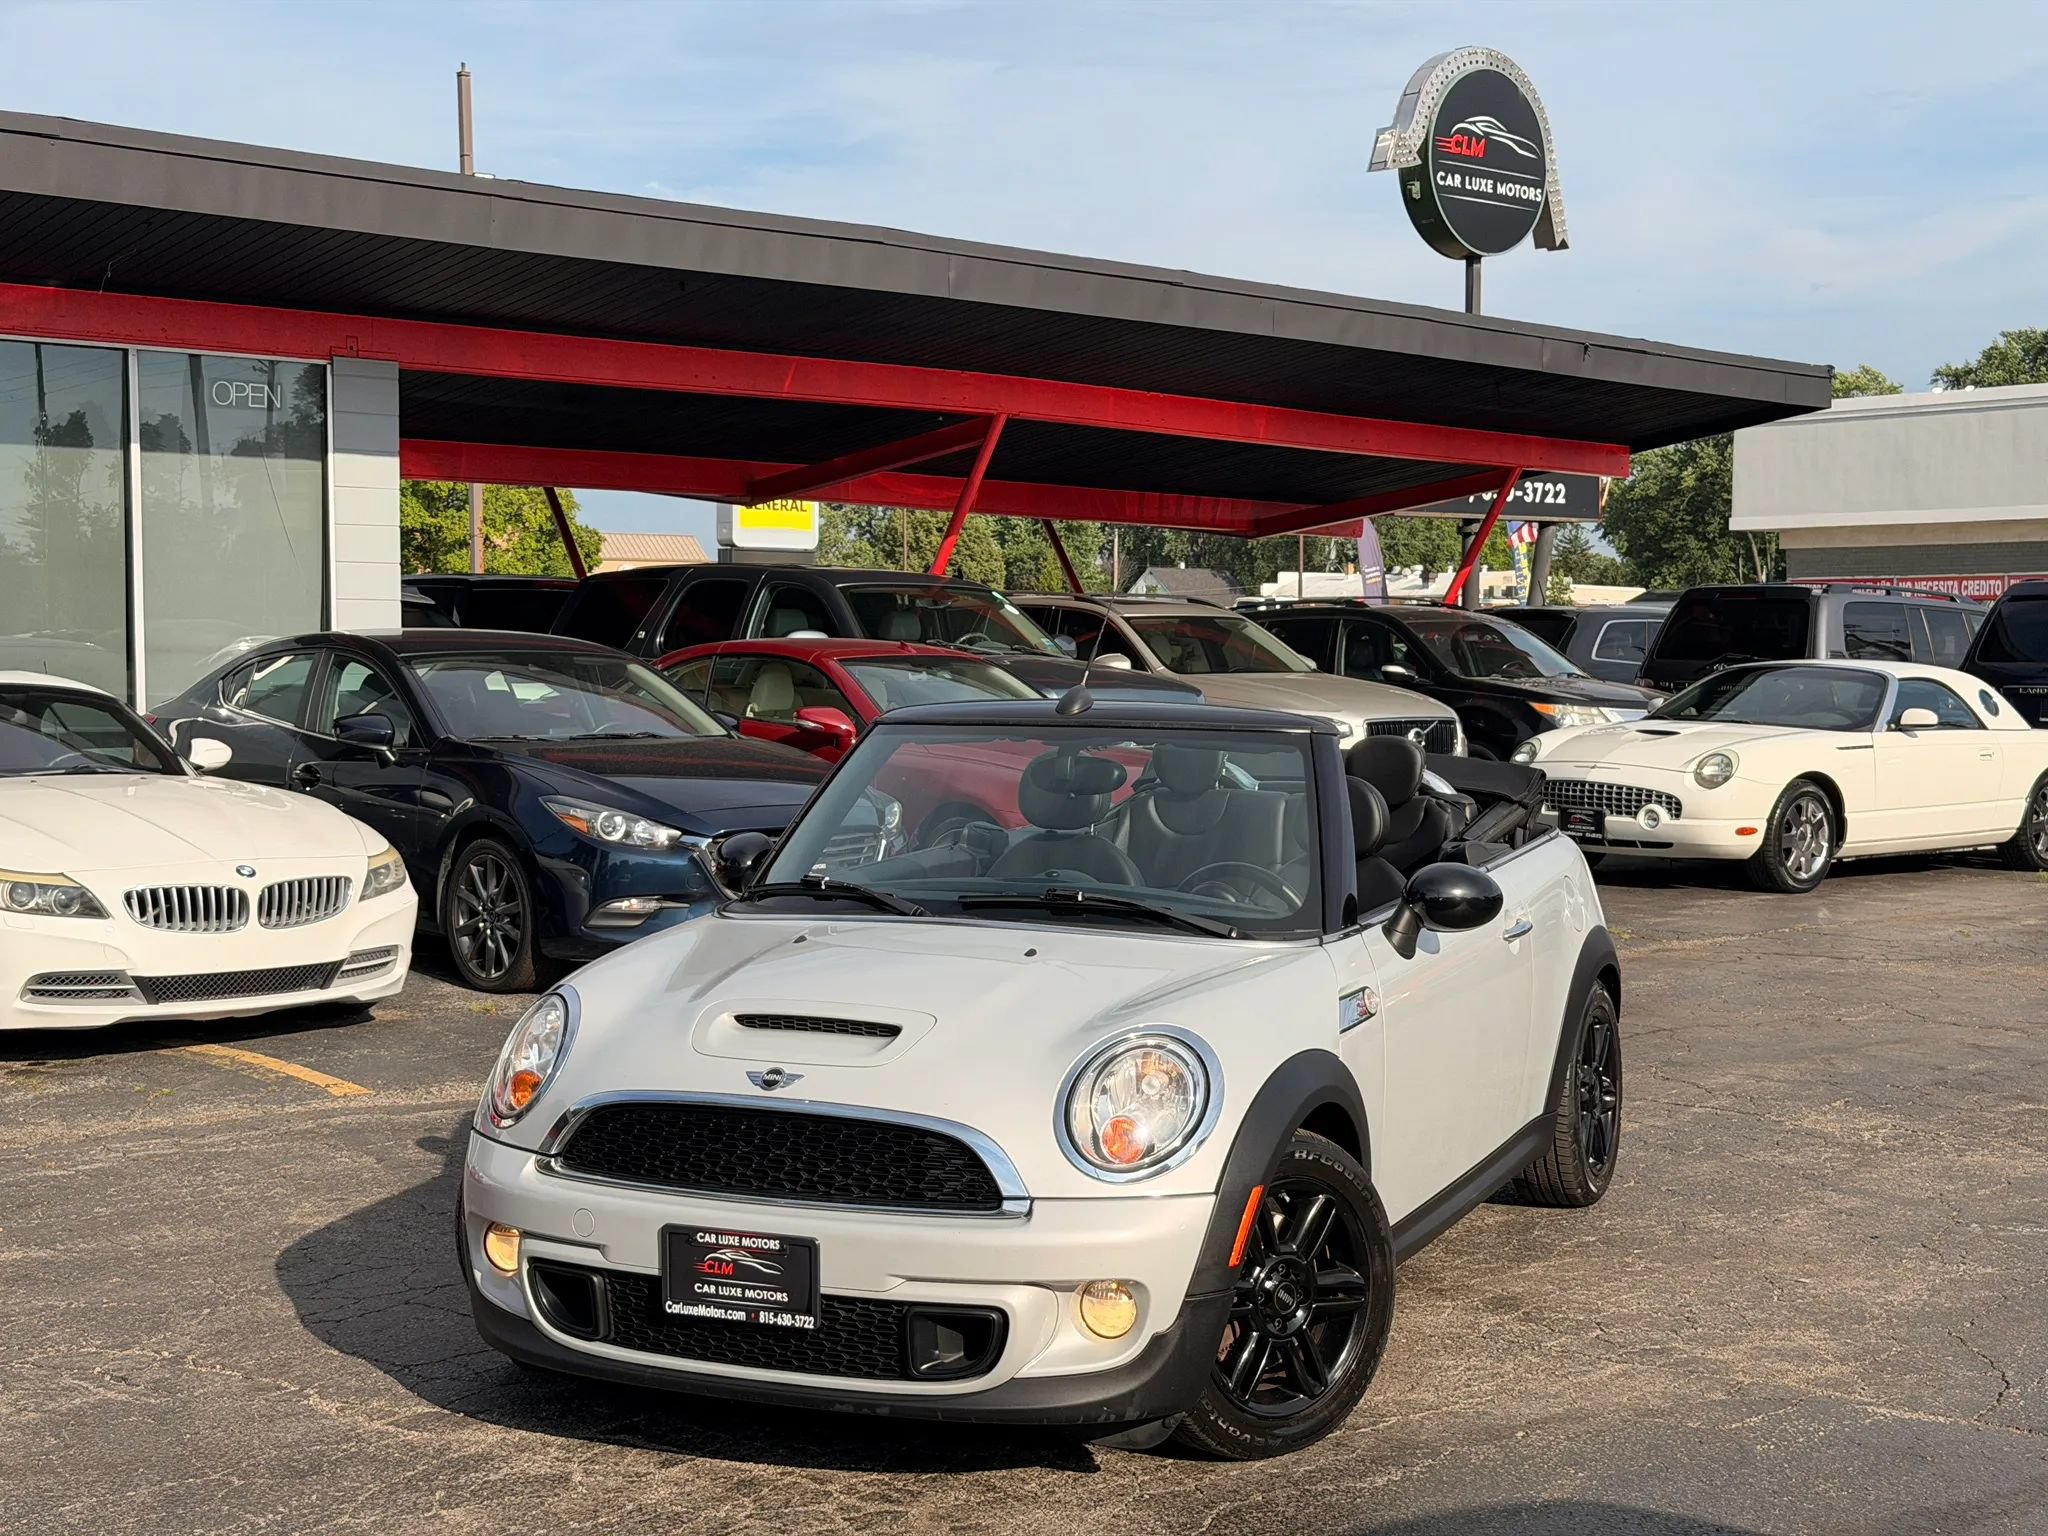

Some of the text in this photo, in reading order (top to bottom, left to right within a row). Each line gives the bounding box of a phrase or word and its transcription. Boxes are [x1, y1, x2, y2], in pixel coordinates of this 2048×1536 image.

[1451, 134, 1487, 158] CLM
[1437, 171, 1542, 202] CAR LUXE MOTORS
[212, 381, 281, 409] OPEN
[1482, 481, 1566, 504] -3722
[746, 498, 808, 512] NERAL
[1961, 579, 2002, 596] CREDITO
[696, 1232, 780, 1250] CAR LUXE MOTORS
[704, 1260, 734, 1276] CLM
[694, 1283, 789, 1302] CAR LUXE MOTORS
[665, 1301, 815, 1329] CarLuxeMotors.com 815-630-3722
